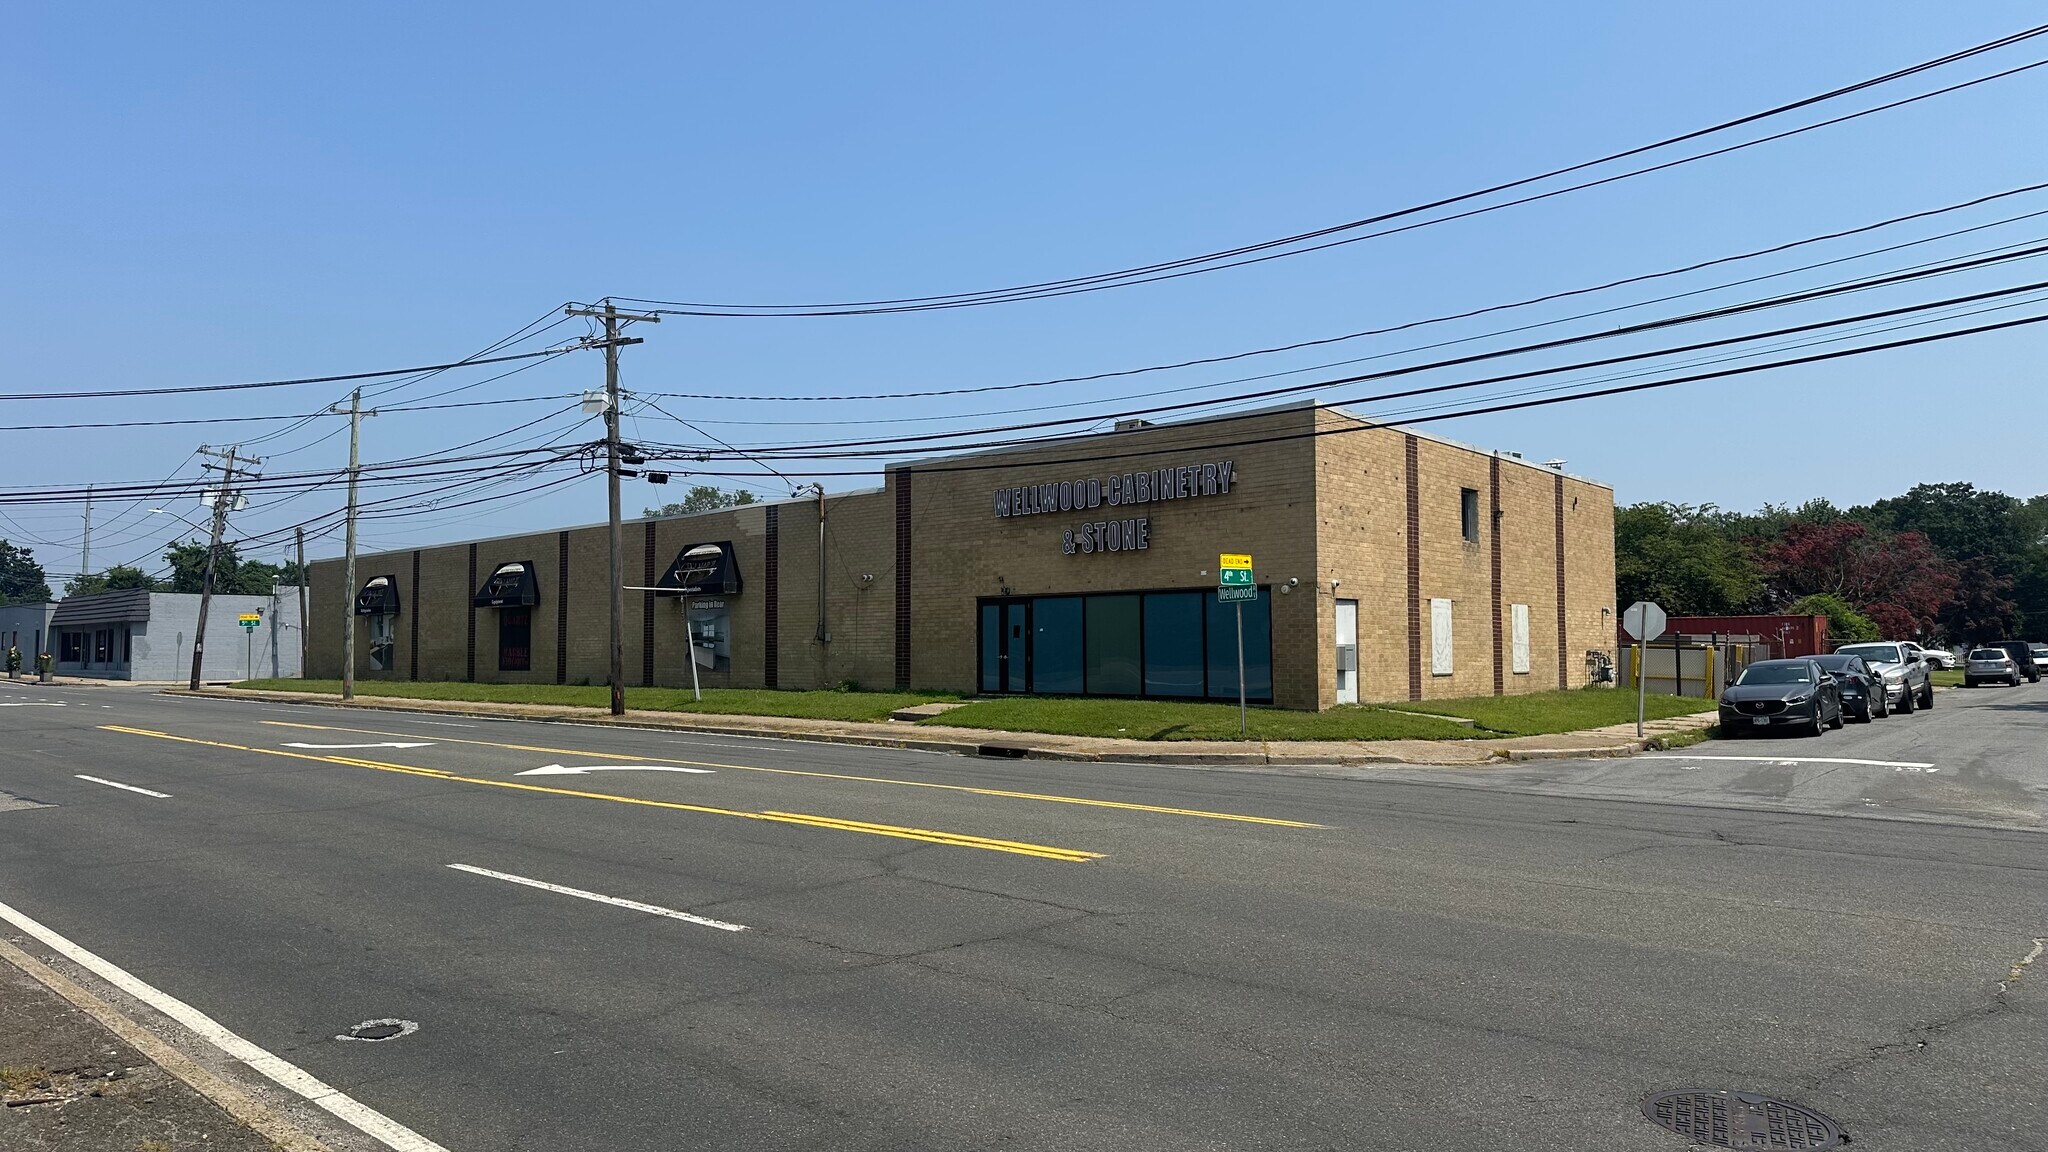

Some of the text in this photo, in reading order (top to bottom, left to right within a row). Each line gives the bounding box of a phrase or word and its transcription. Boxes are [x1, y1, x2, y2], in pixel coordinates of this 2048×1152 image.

[993, 460, 1233, 518] WELLWOOD CABINETRY
[1062, 518, 1148, 555] & STONE
[1224, 570, 1233, 582] 4th
[1220, 586, 1253, 600] Wellwood
[691, 600, 709, 610] Parking
